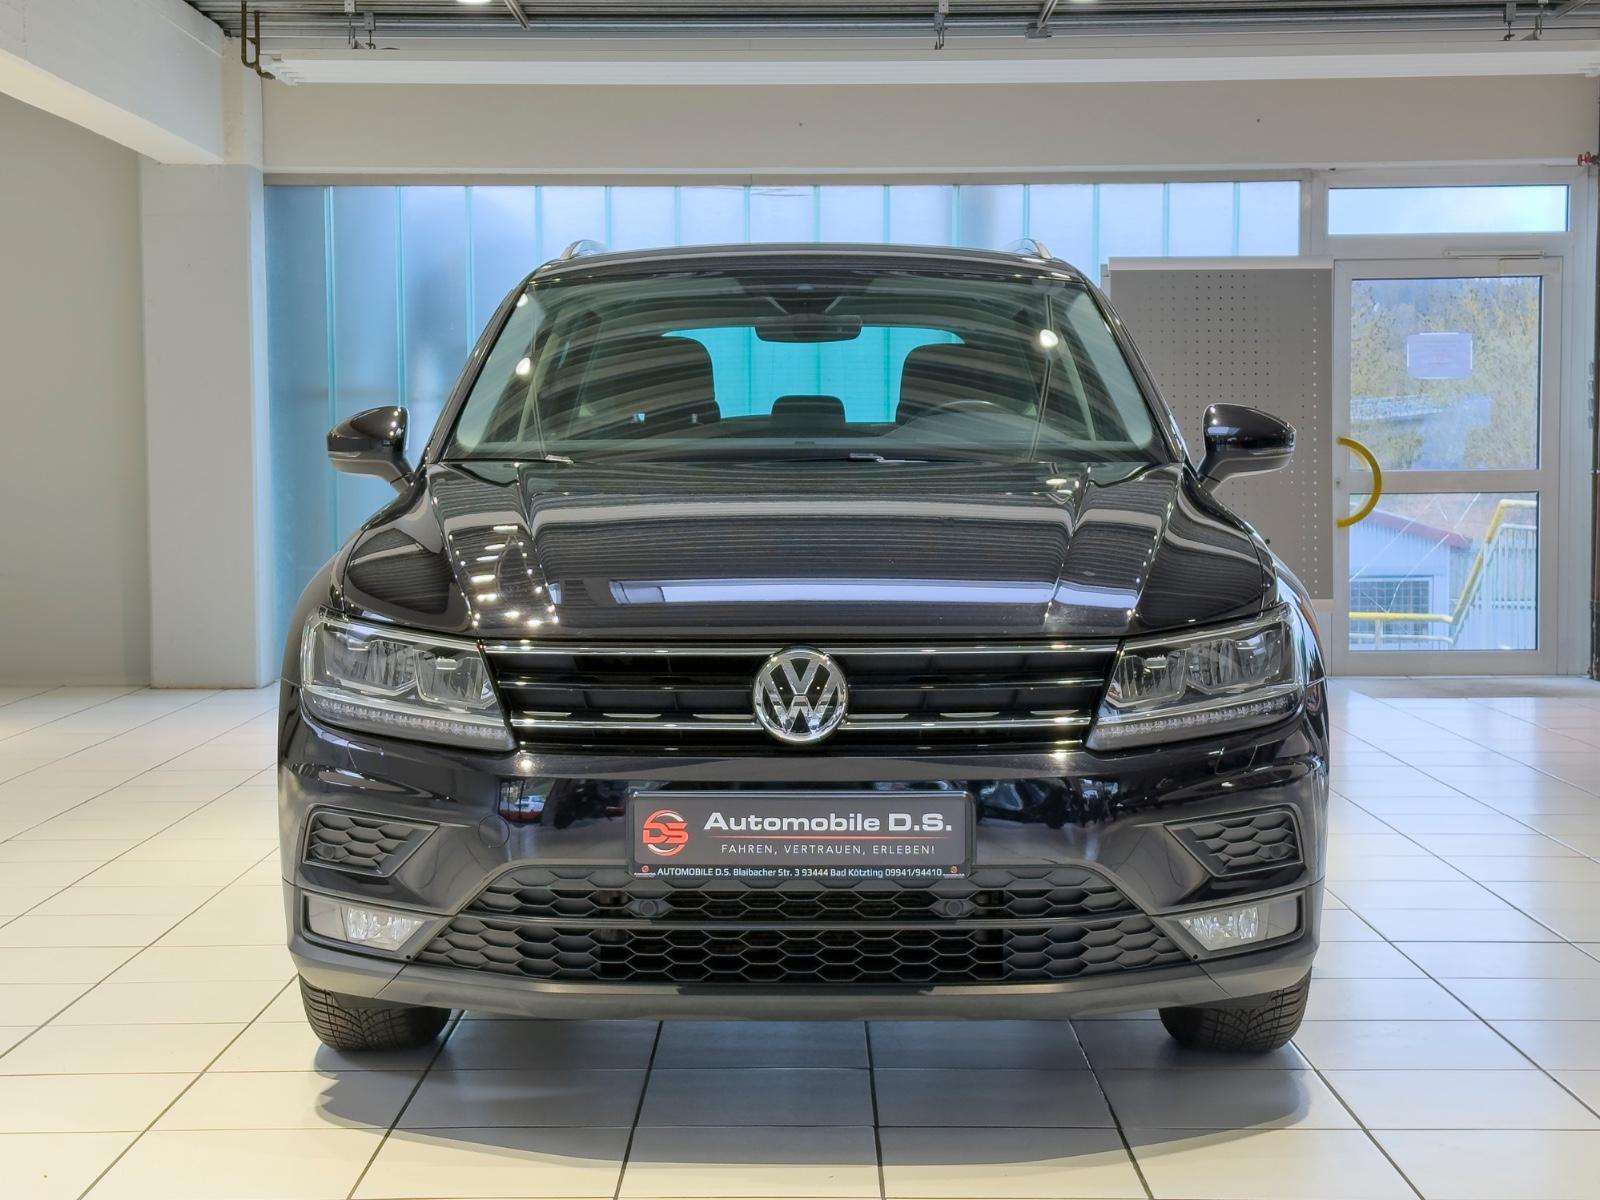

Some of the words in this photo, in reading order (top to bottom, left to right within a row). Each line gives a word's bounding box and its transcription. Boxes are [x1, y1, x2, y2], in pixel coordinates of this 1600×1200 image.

[754, 650, 847, 742] VW
[704, 812, 881, 831] Automobile
[888, 813, 952, 831] D.S.
[721, 844, 777, 855] FAHREN,
[784, 844, 866, 855] VERTRAUEN,
[873, 844, 935, 855] ERLEBEN!
[657, 867, 713, 876] AUTOMOBILE
[715, 867, 731, 876] D.S.
[733, 867, 776, 877] Blaibacher
[778, 868, 793, 877] Str.
[794, 868, 800, 877] 3
[801, 868, 829, 877] 93444
[830, 868, 847, 877] Bad
[848, 868, 883, 878] Kötzting
[885, 868, 942, 877] 09941/94410
